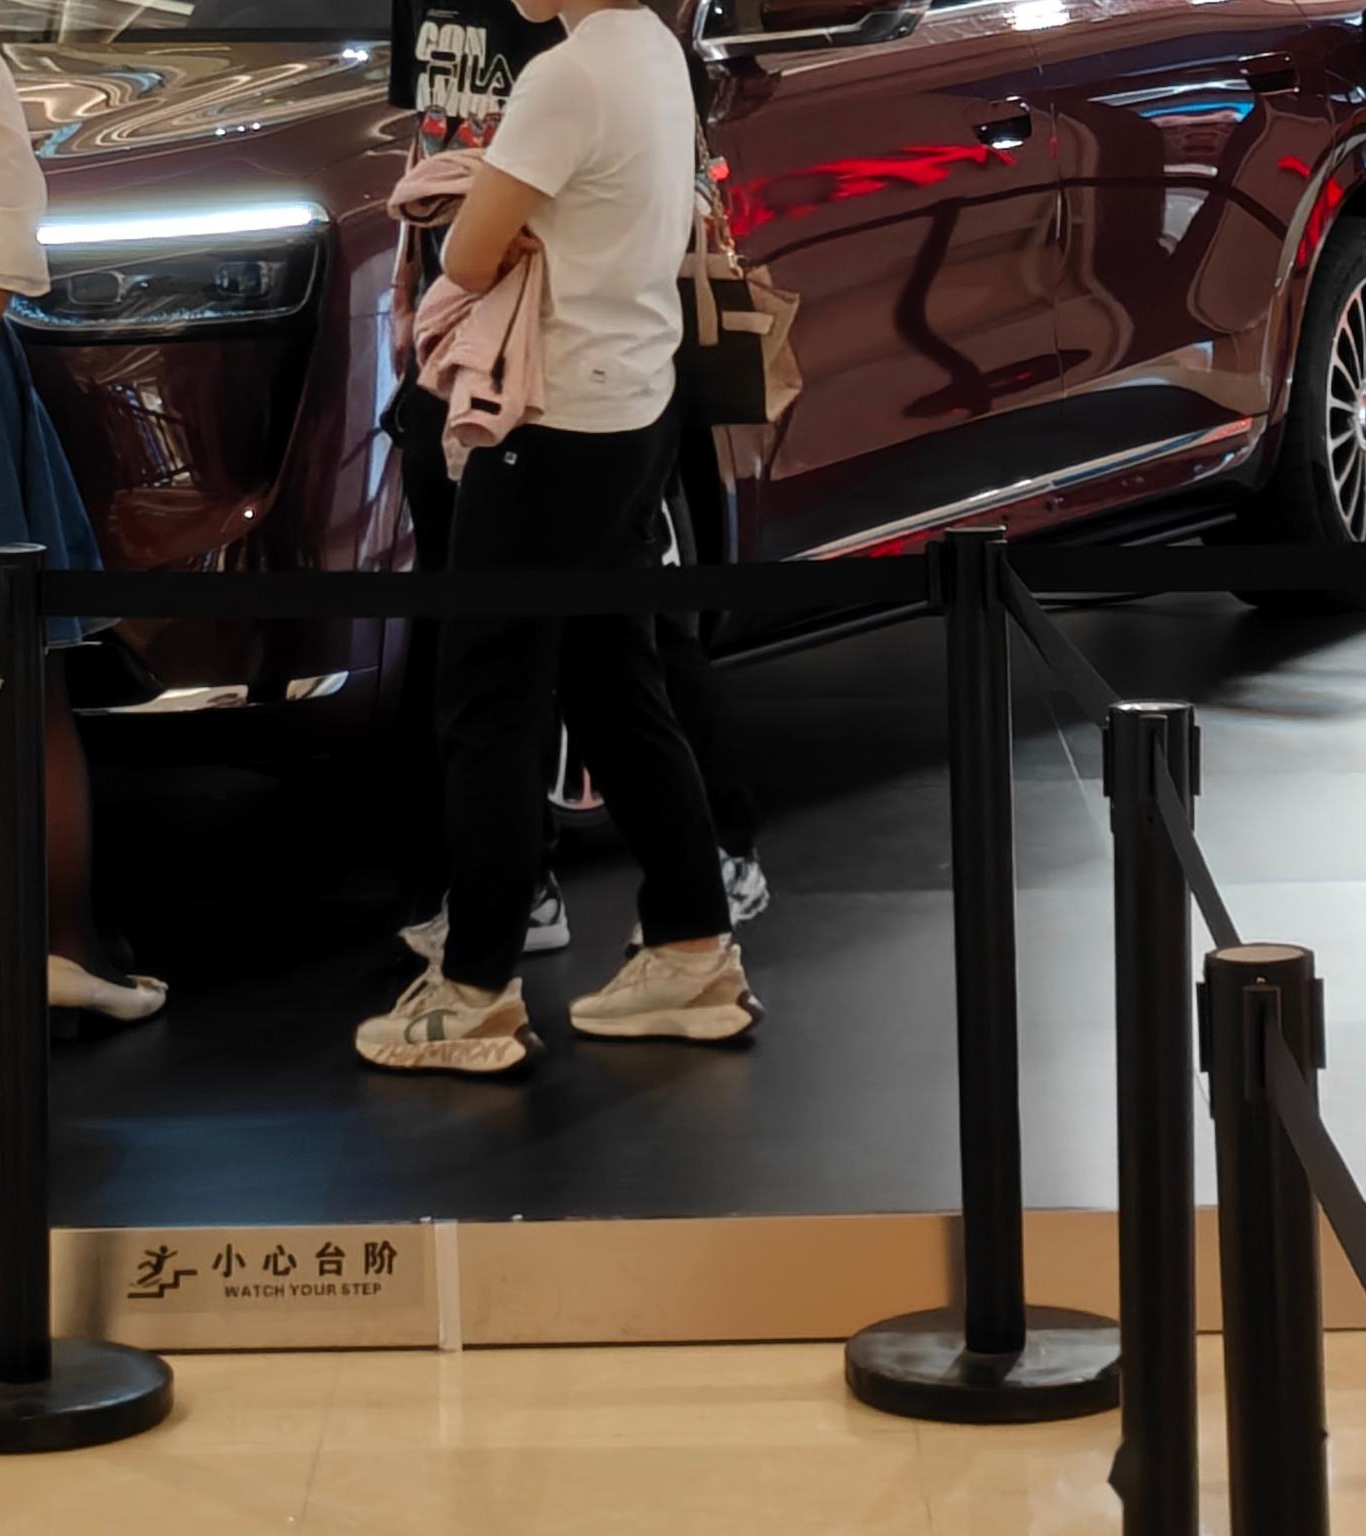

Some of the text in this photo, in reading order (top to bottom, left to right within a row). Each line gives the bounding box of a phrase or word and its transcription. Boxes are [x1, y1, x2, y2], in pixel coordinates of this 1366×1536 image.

[428, 50, 514, 98] FILA
[212, 1240, 398, 1278] 小心台阶
[224, 1283, 382, 1298] WATCH YOUR STEP
